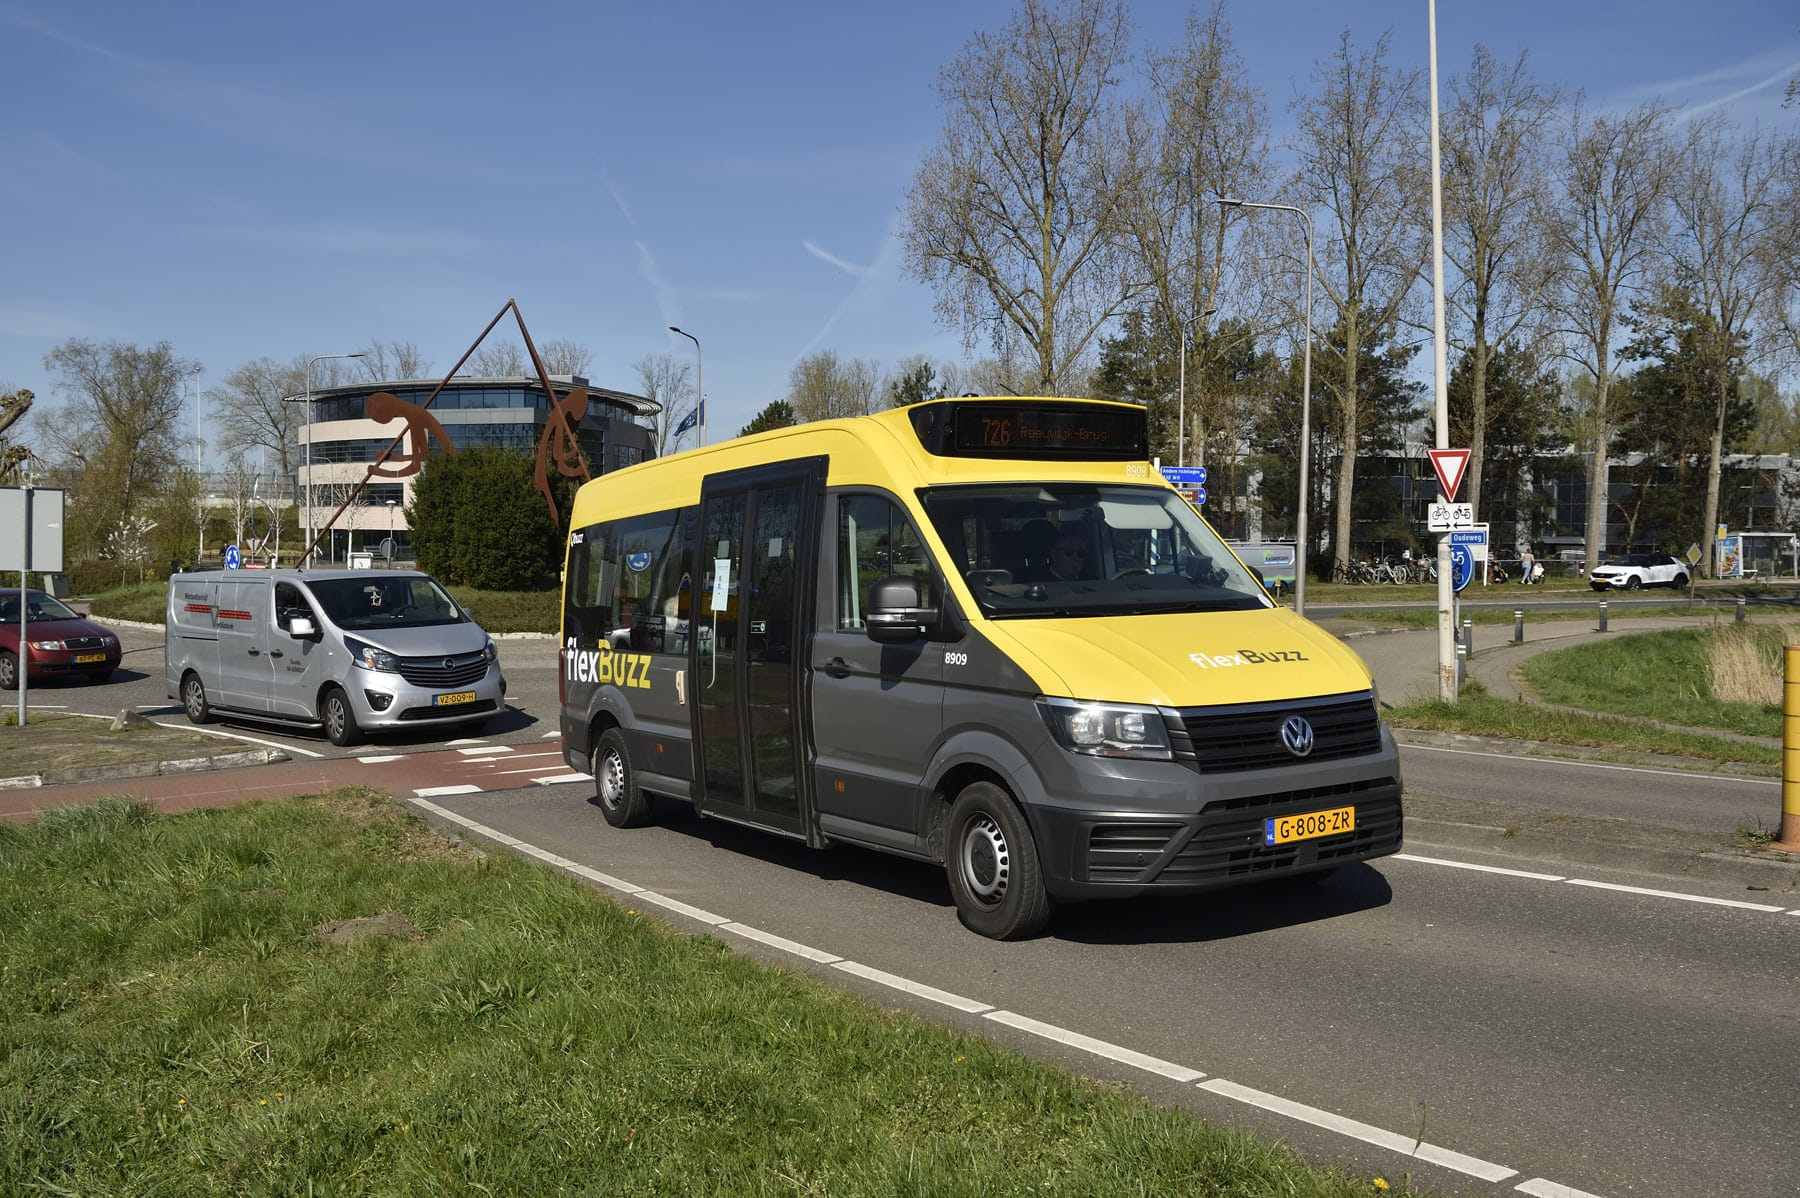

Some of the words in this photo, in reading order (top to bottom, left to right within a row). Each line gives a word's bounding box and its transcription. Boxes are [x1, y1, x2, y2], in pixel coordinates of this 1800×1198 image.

[981, 418, 1011, 446] 726
[1019, 426, 1110, 441] Reeuwijk-Brug
[1126, 464, 1147, 477] 8909
[1453, 534, 1482, 543] Oudeweg
[566, 636, 652, 689] flexBuzz
[944, 651, 968, 666] 8909
[1188, 650, 1310, 669] flexBuzz
[1280, 811, 1350, 839] G-808-ZR
